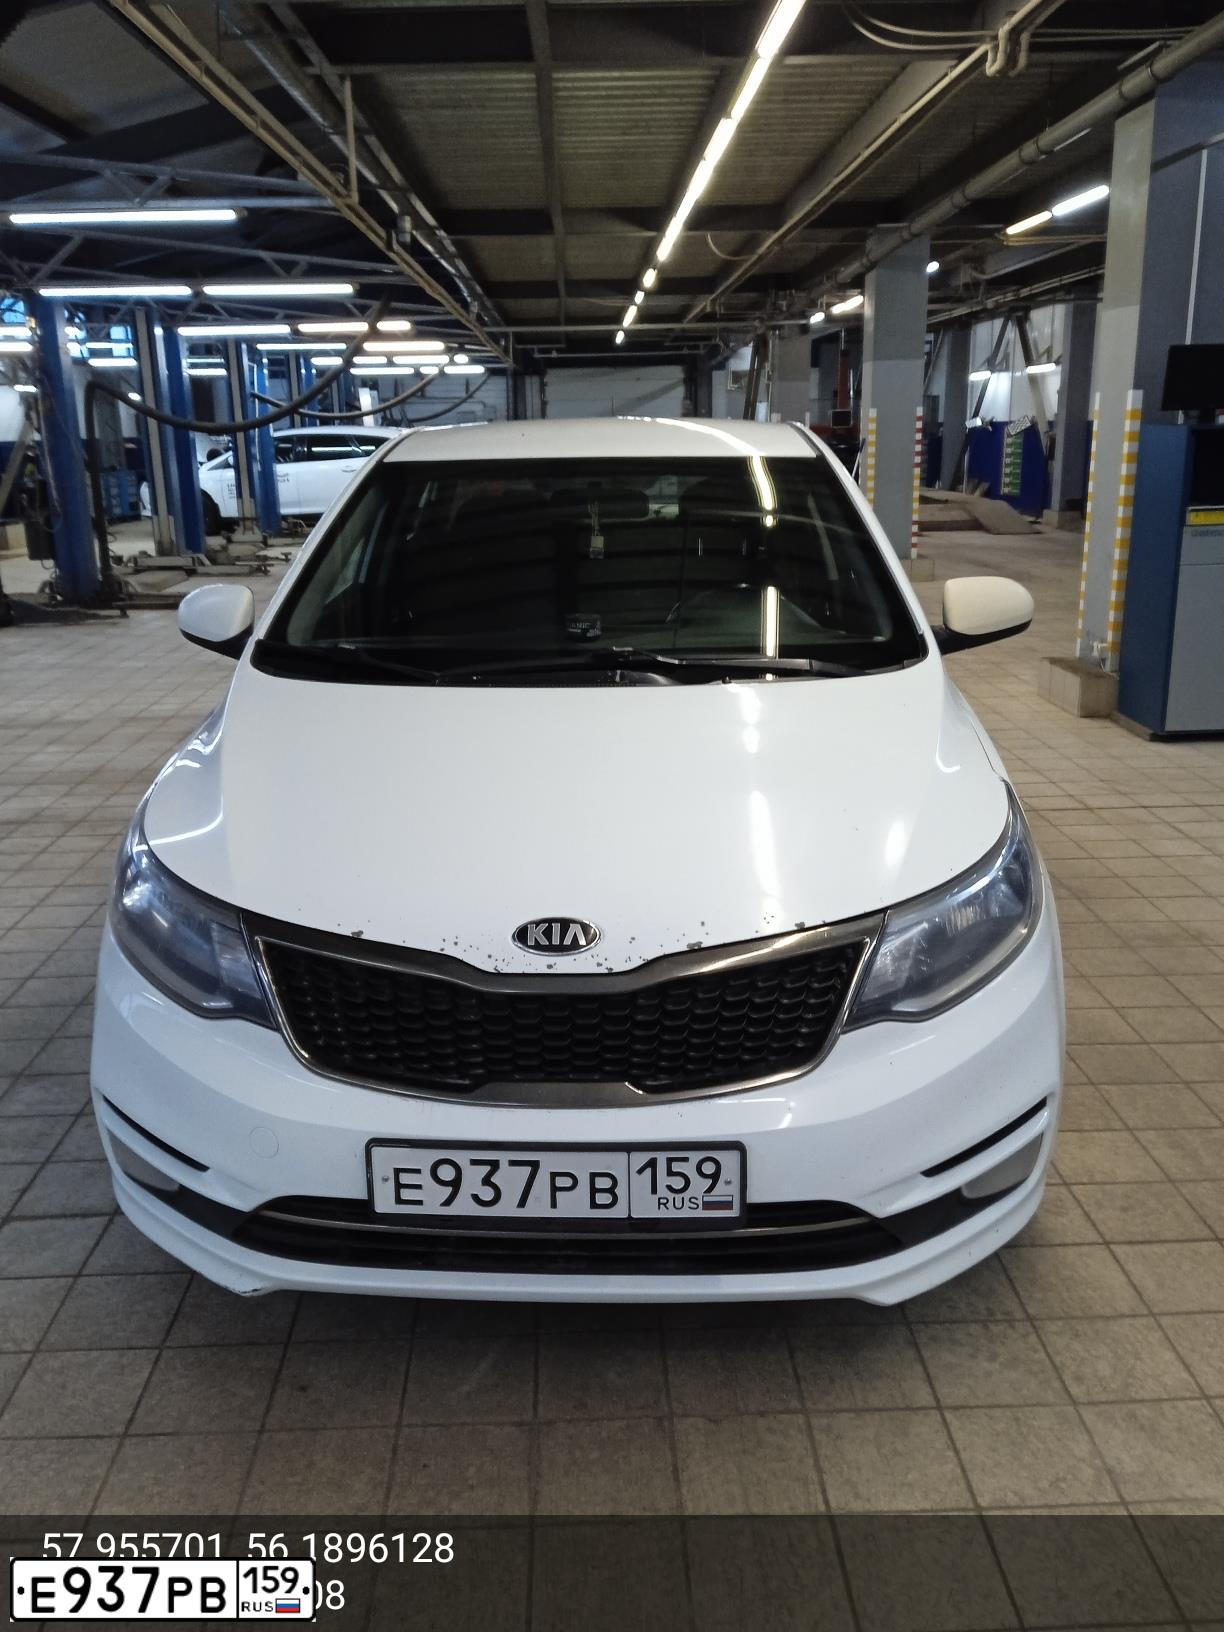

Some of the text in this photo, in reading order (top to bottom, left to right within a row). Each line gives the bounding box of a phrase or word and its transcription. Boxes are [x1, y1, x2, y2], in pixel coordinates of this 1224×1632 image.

[527, 923, 587, 946] KIA
[636, 1156, 722, 1195] 159
[658, 1196, 700, 1211] RUS
